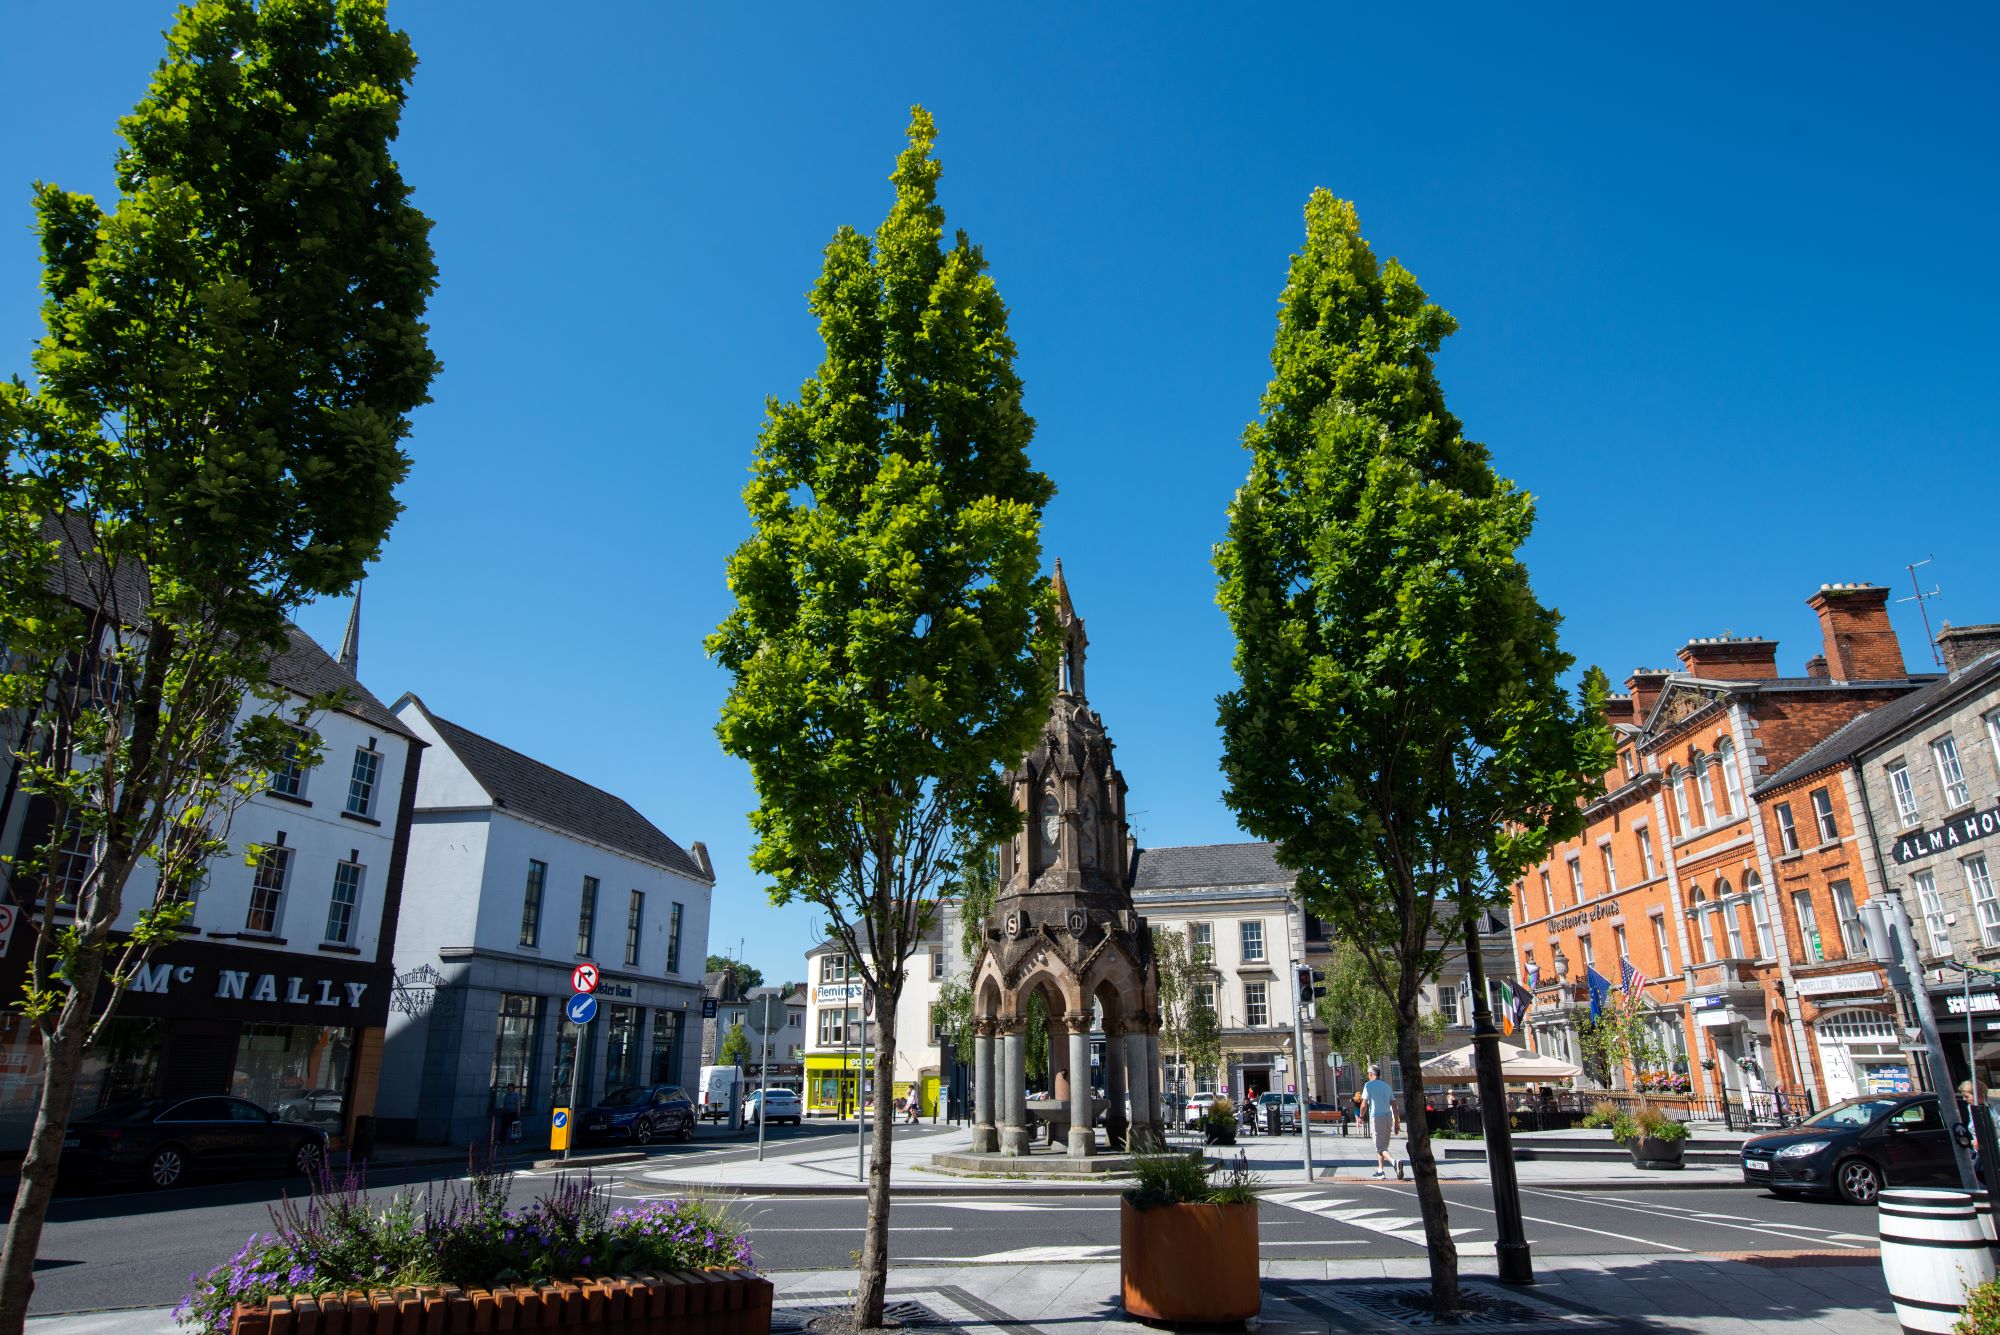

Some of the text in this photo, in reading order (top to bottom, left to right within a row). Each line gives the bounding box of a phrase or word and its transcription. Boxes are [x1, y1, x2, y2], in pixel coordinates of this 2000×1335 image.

[1903, 827, 1960, 861] ALMA
[214, 969, 369, 1008] NALLY
[615, 984, 633, 998] Bank
[817, 984, 862, 998] Fleming's
[1799, 975, 1875, 993] JEWELLERY BOUTIQUE
[851, 1058, 875, 1067] eaon
